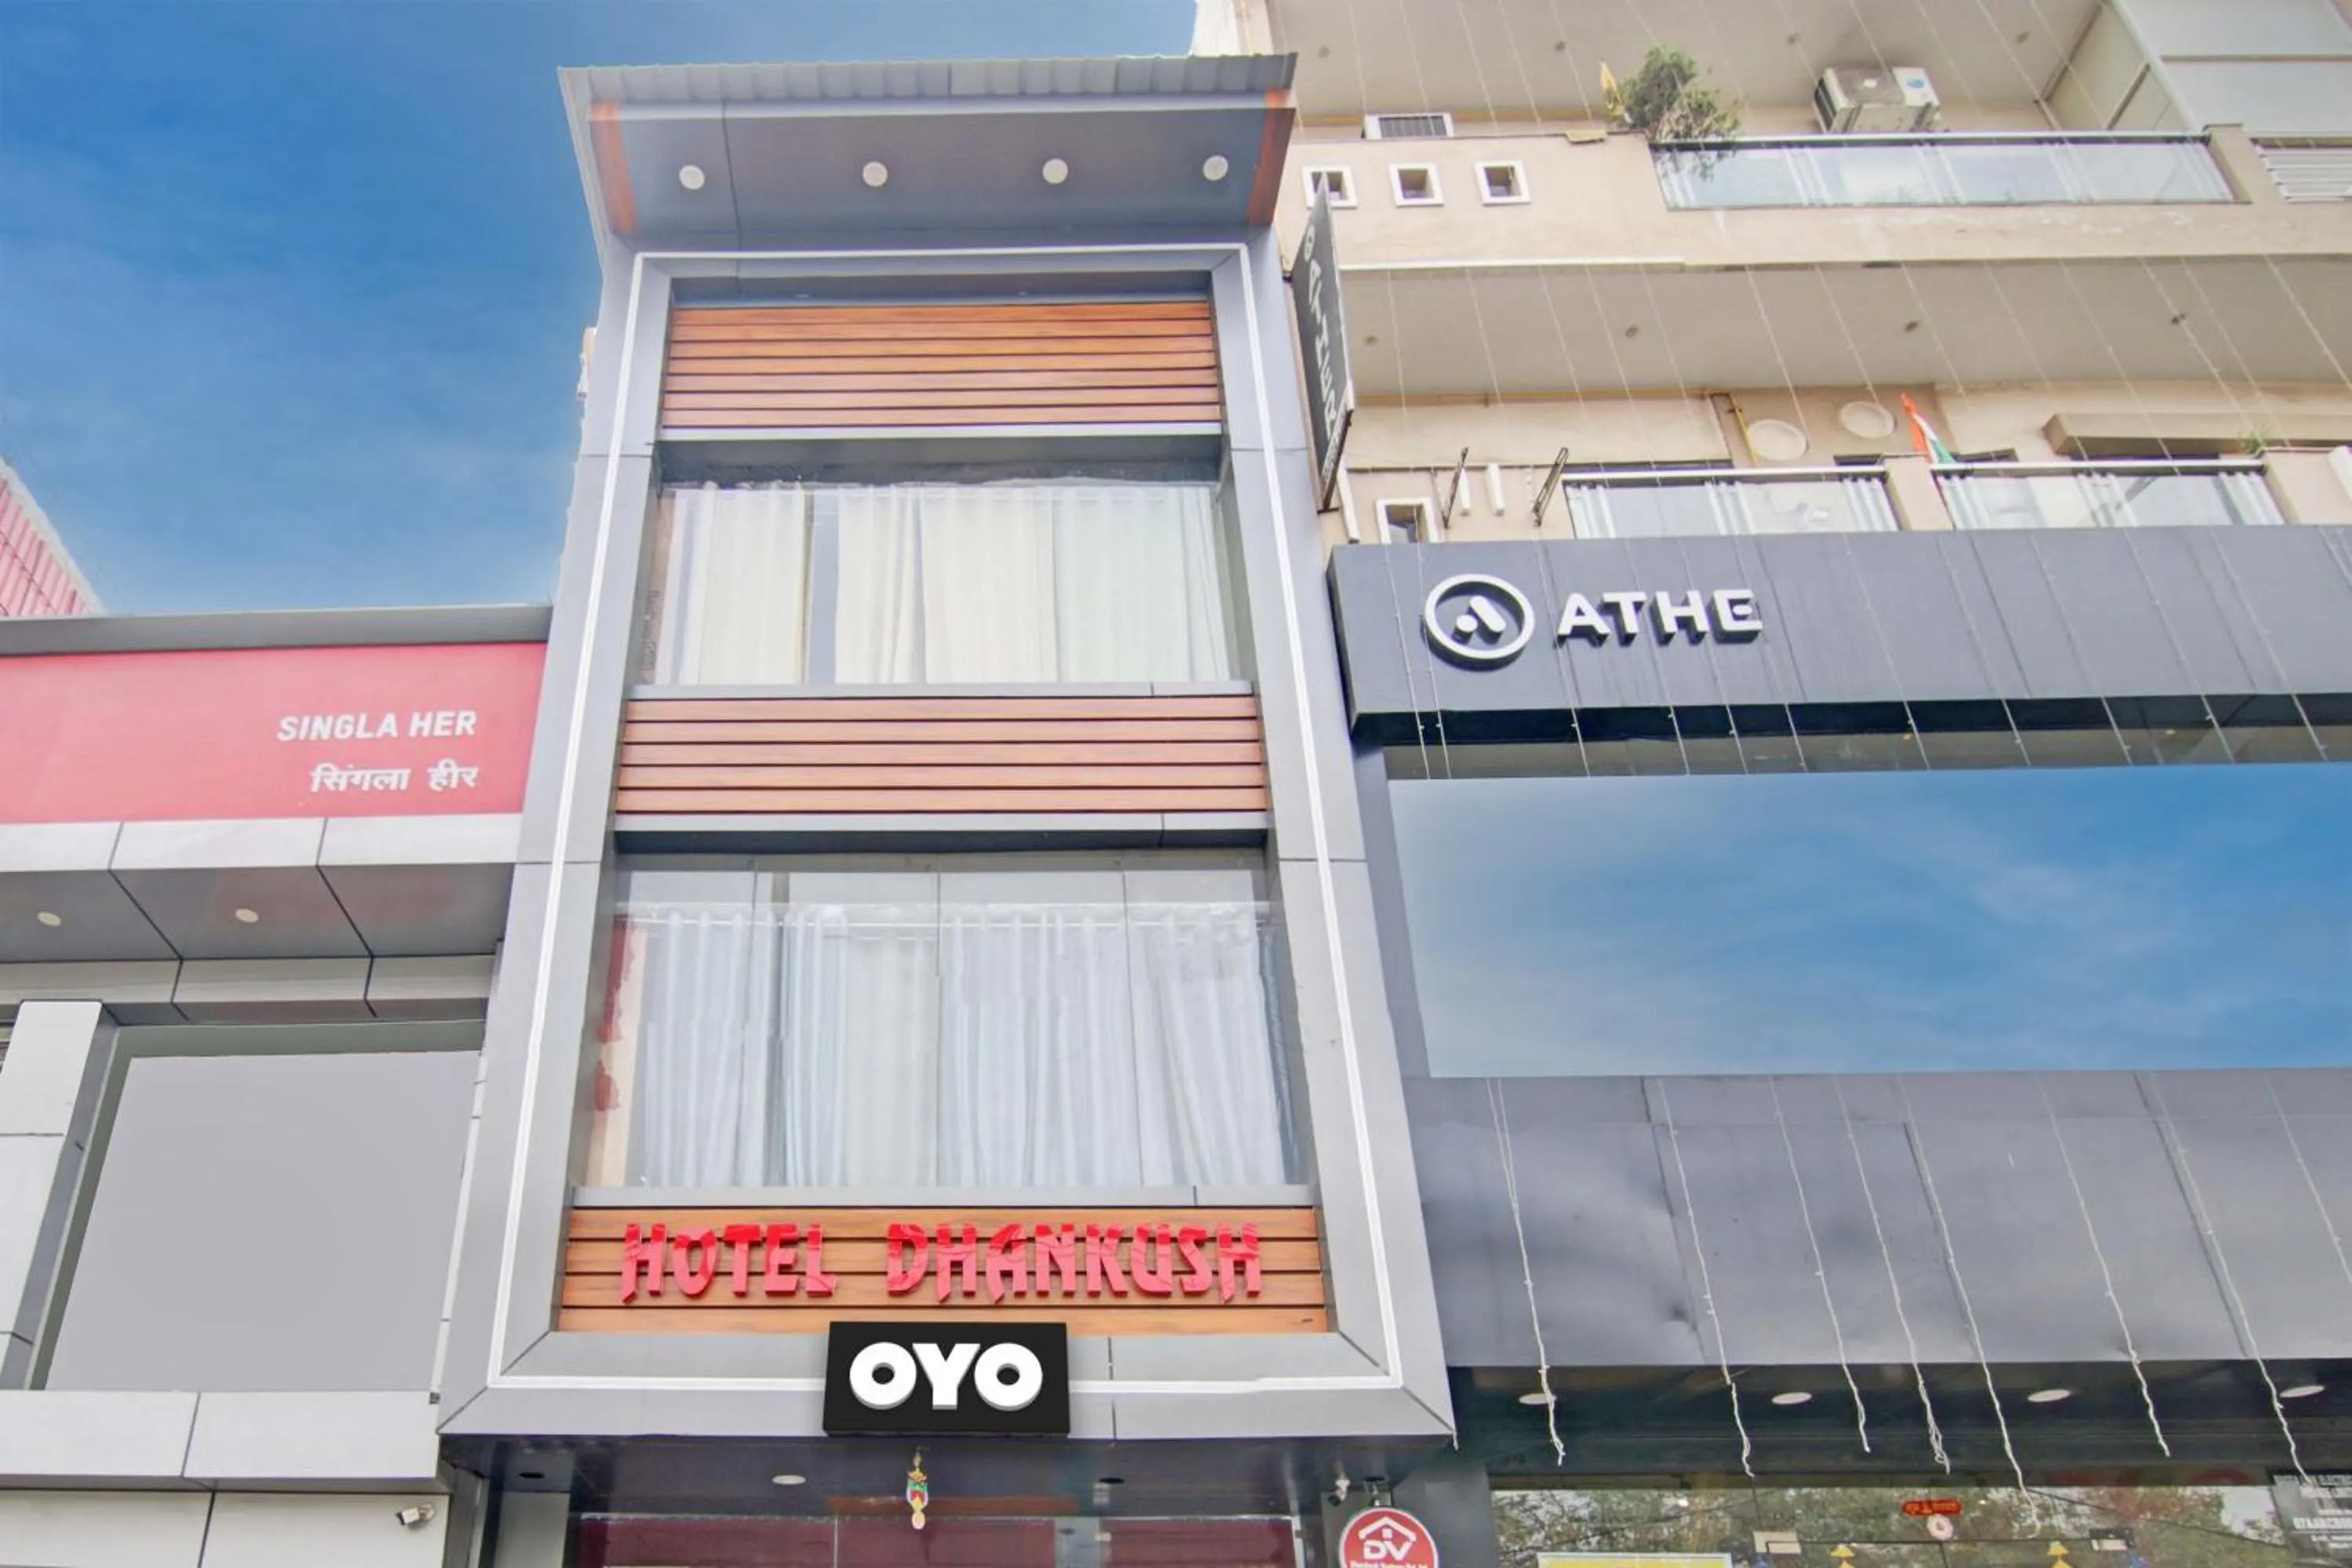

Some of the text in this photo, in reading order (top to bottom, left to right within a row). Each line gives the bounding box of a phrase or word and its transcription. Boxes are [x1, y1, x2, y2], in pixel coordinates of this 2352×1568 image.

[1556, 589, 1762, 643] ATHE
[277, 710, 477, 742] SINGLA HER
[310, 757, 480, 793] सिंगला हीर
[621, 1223, 1263, 1303] HOTEL DHANKUSH
[849, 1341, 1043, 1410] OYO
